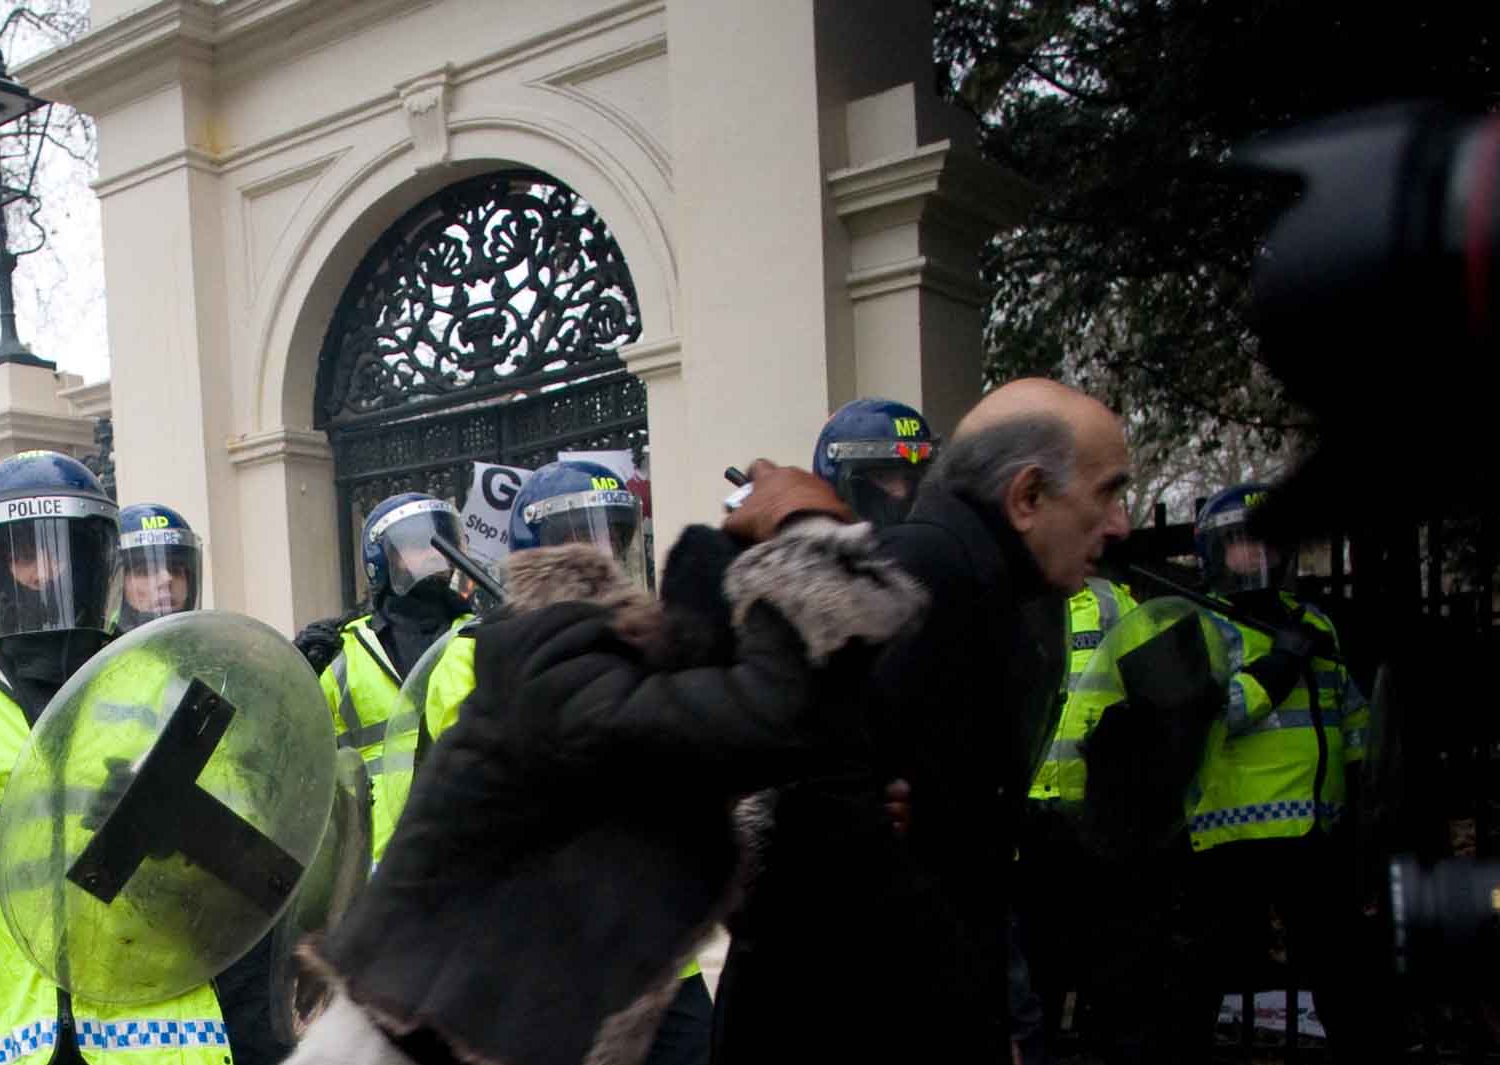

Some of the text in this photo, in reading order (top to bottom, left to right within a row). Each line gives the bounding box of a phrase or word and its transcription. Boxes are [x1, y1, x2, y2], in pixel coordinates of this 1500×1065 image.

[895, 418, 920, 437] MP
[482, 467, 522, 511] G
[591, 477, 619, 491] MP
[8, 500, 61, 519] POLICE
[141, 515, 169, 530] MP
[466, 513, 498, 539] Stop
